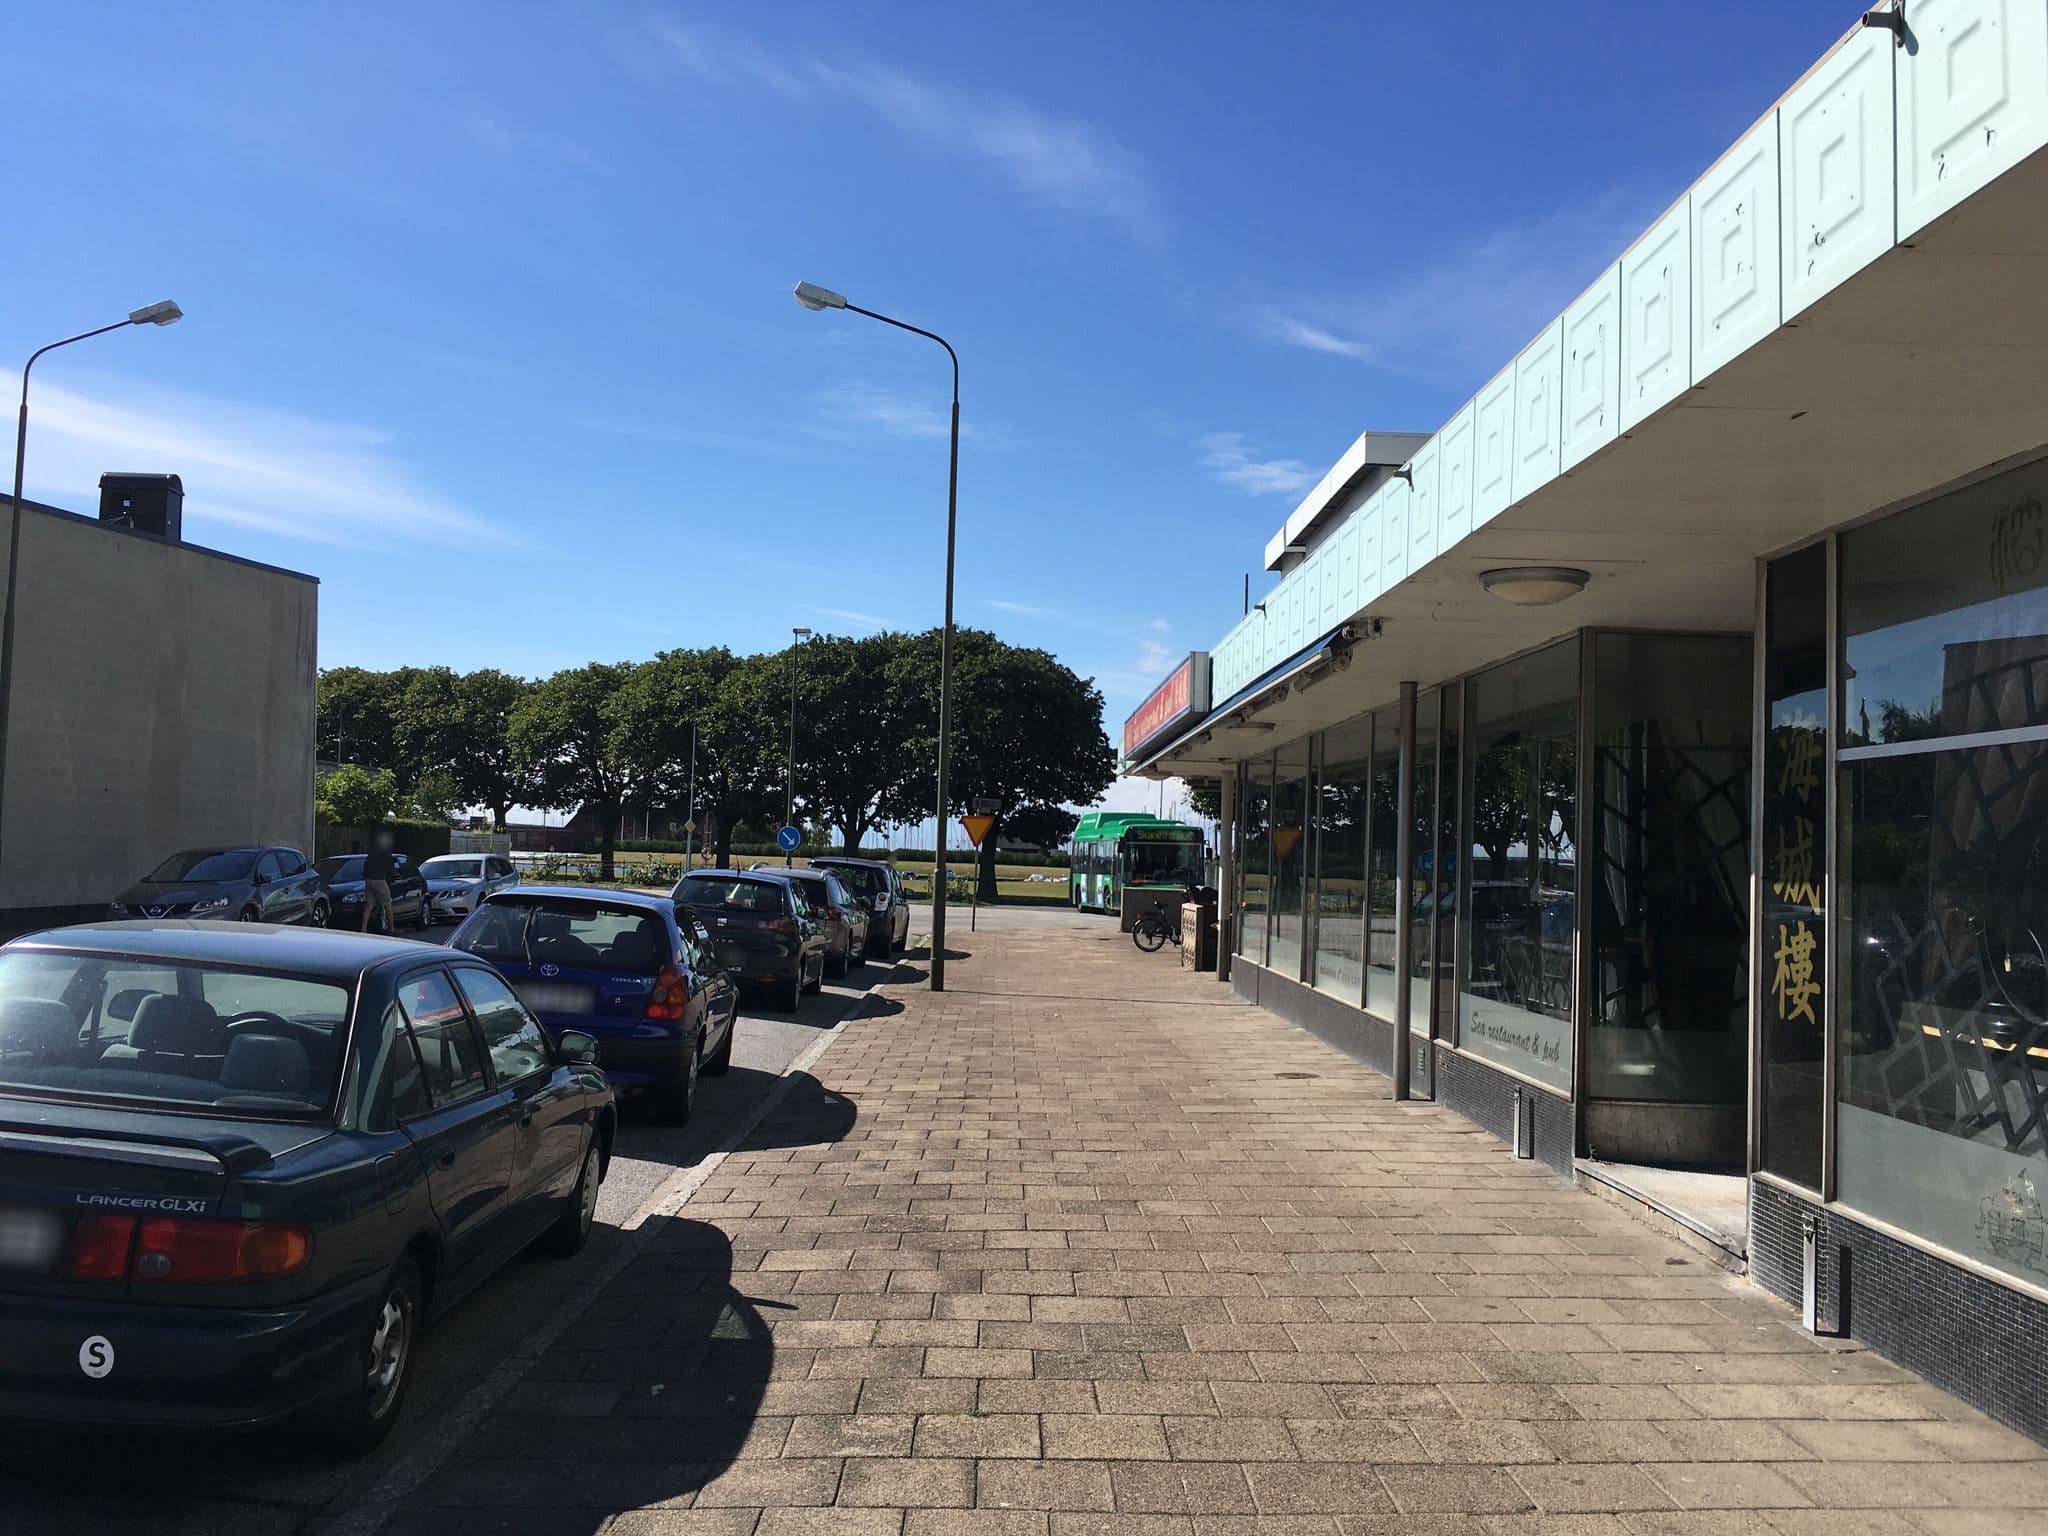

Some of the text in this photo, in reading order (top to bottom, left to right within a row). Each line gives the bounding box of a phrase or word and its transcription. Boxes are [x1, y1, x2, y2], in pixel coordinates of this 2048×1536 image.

[1770, 706, 1822, 1025] 海城樓
[1470, 1011, 1561, 1062] Sea restaurant & pub
[75, 1194, 206, 1213] LANCER GLXi
[87, 1341, 106, 1368] S
